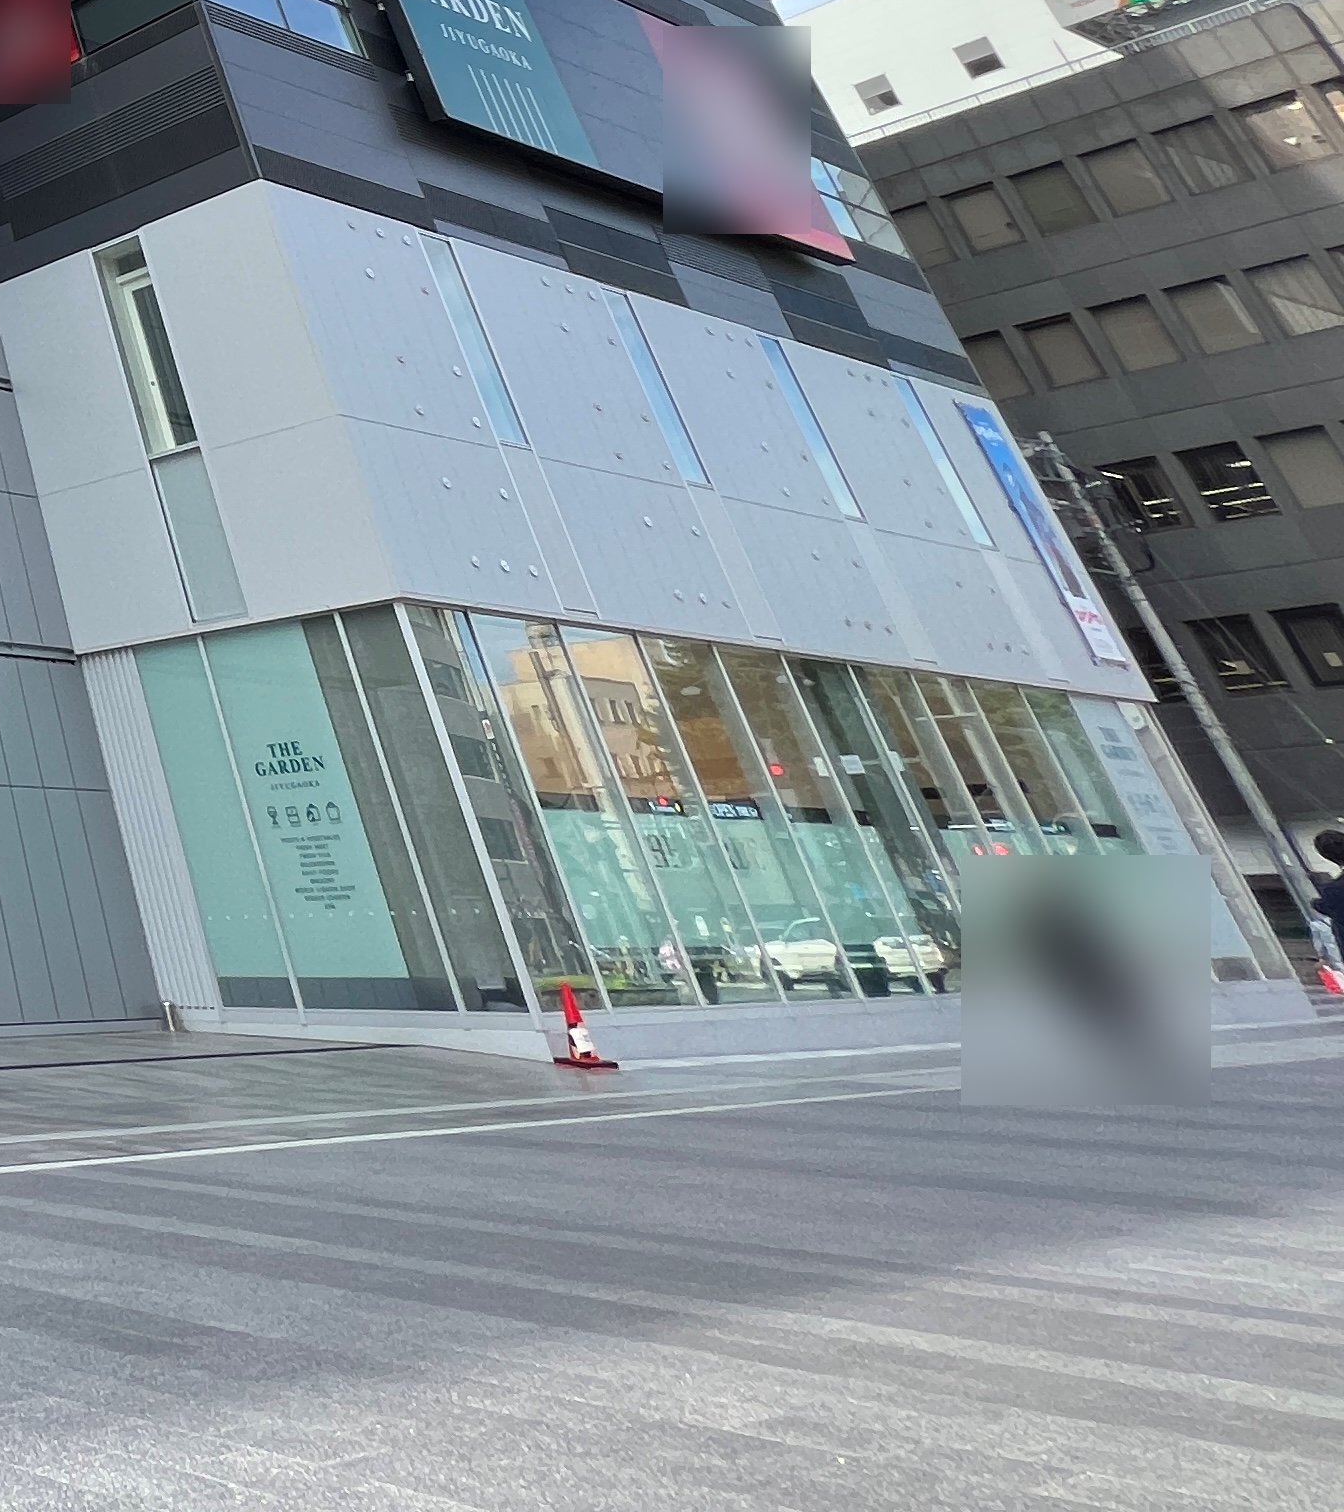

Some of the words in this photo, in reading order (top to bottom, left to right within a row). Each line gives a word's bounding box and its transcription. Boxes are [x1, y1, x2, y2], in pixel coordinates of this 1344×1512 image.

[440, 22, 533, 72] JIYUGAOKA
[266, 740, 303, 759] THE
[254, 755, 326, 777] GARDEN
